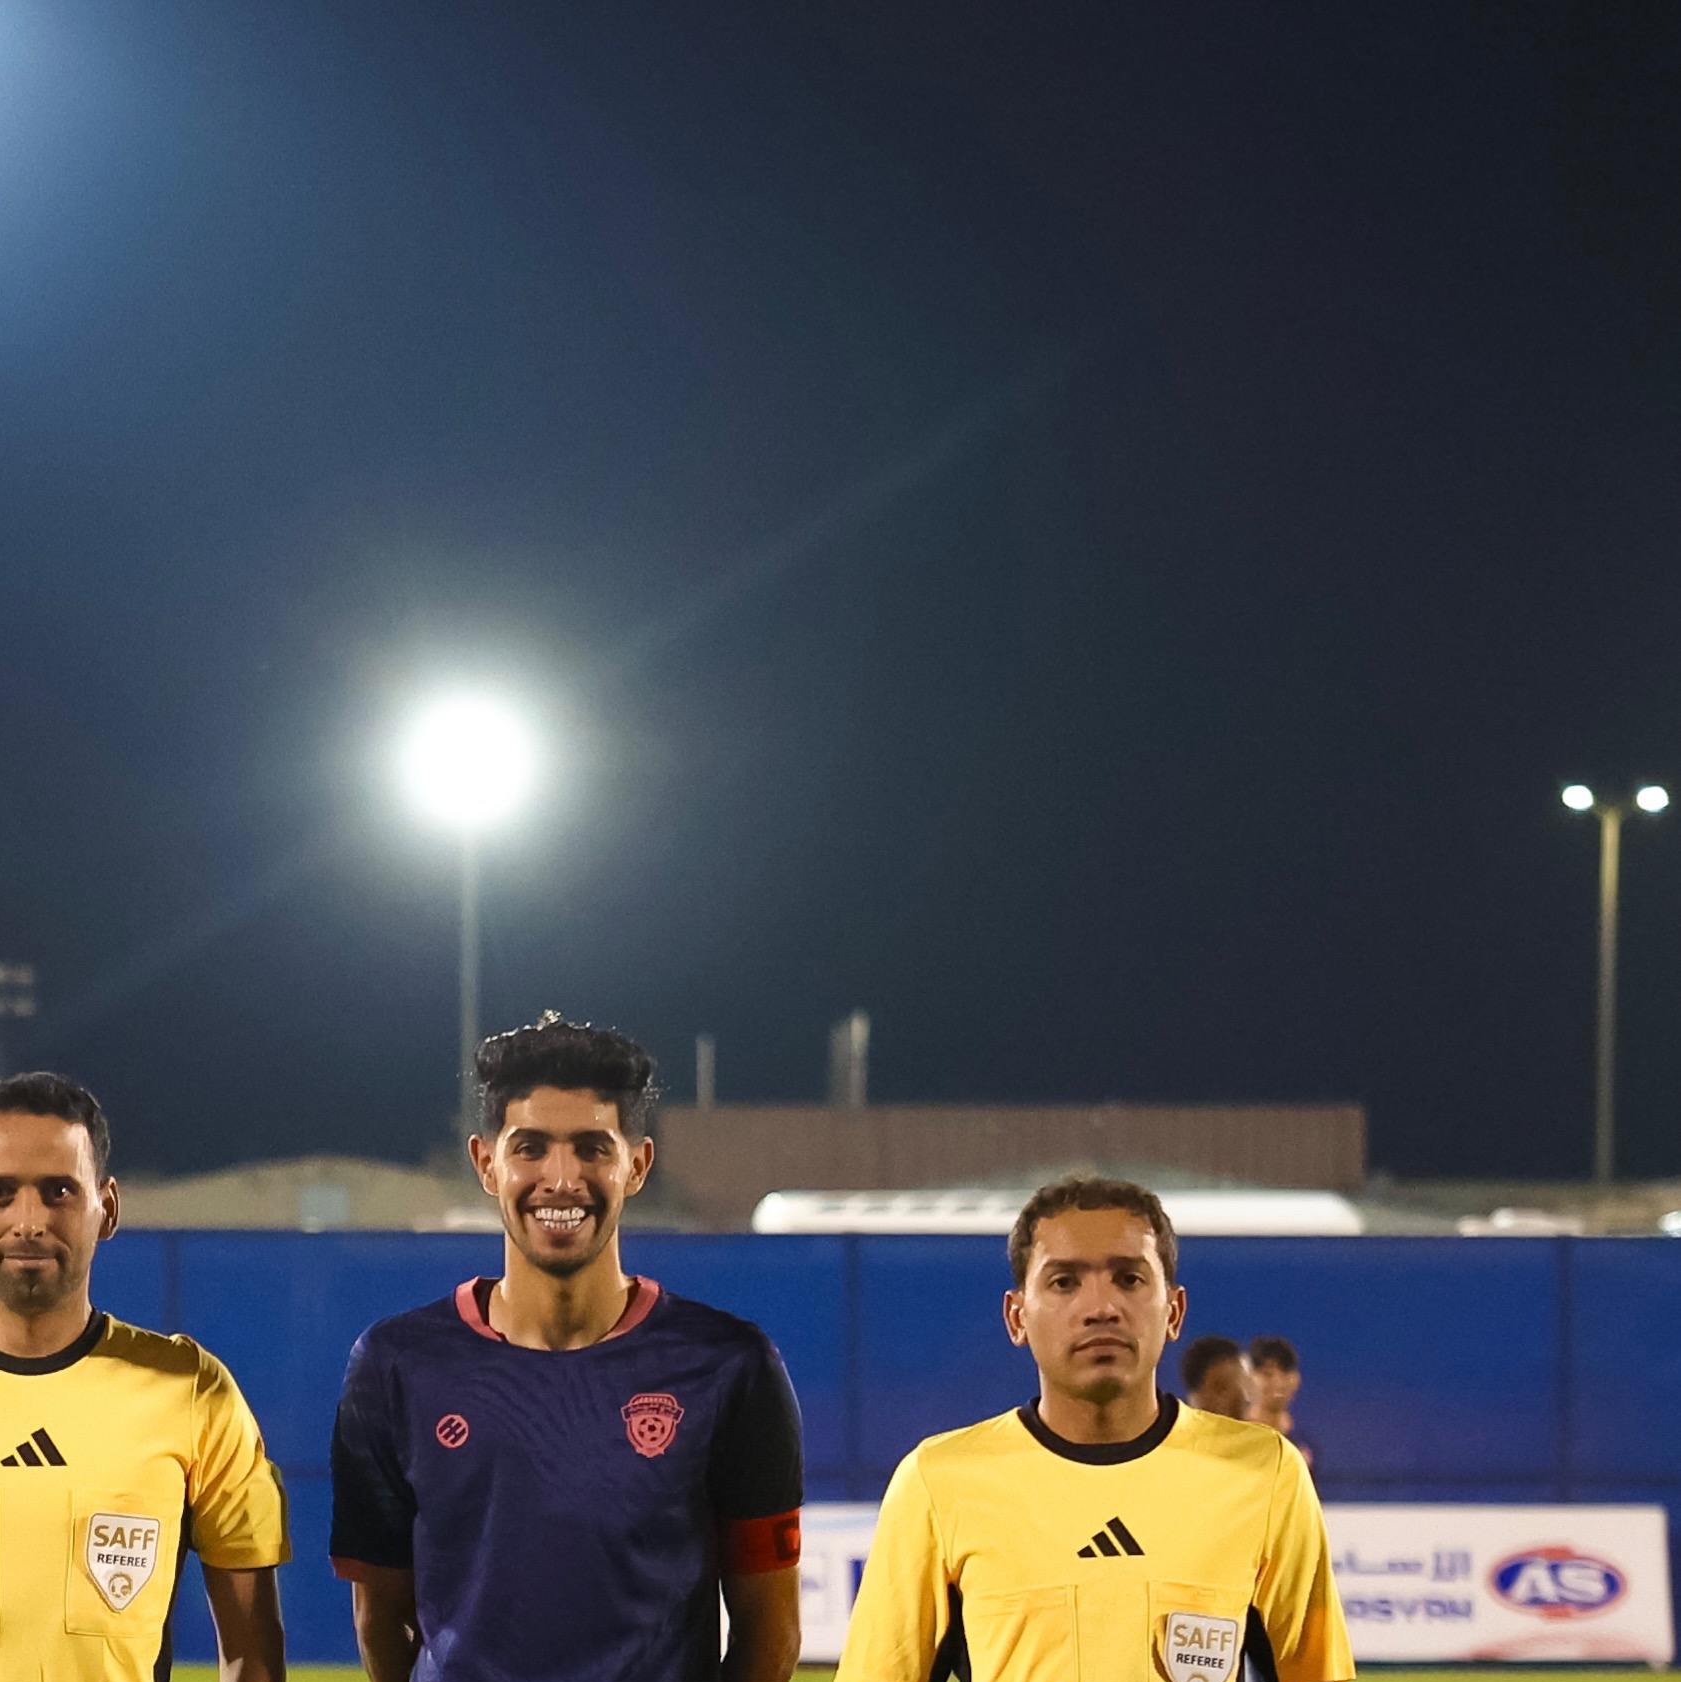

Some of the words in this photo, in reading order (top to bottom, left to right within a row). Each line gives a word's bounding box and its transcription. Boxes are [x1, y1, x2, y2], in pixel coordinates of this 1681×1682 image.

[93, 1525, 155, 1550] SAFF
[97, 1553, 147, 1568] REFEREE
[1173, 1624, 1233, 1652] SAFF
[1176, 1653, 1225, 1669] REFEREE
